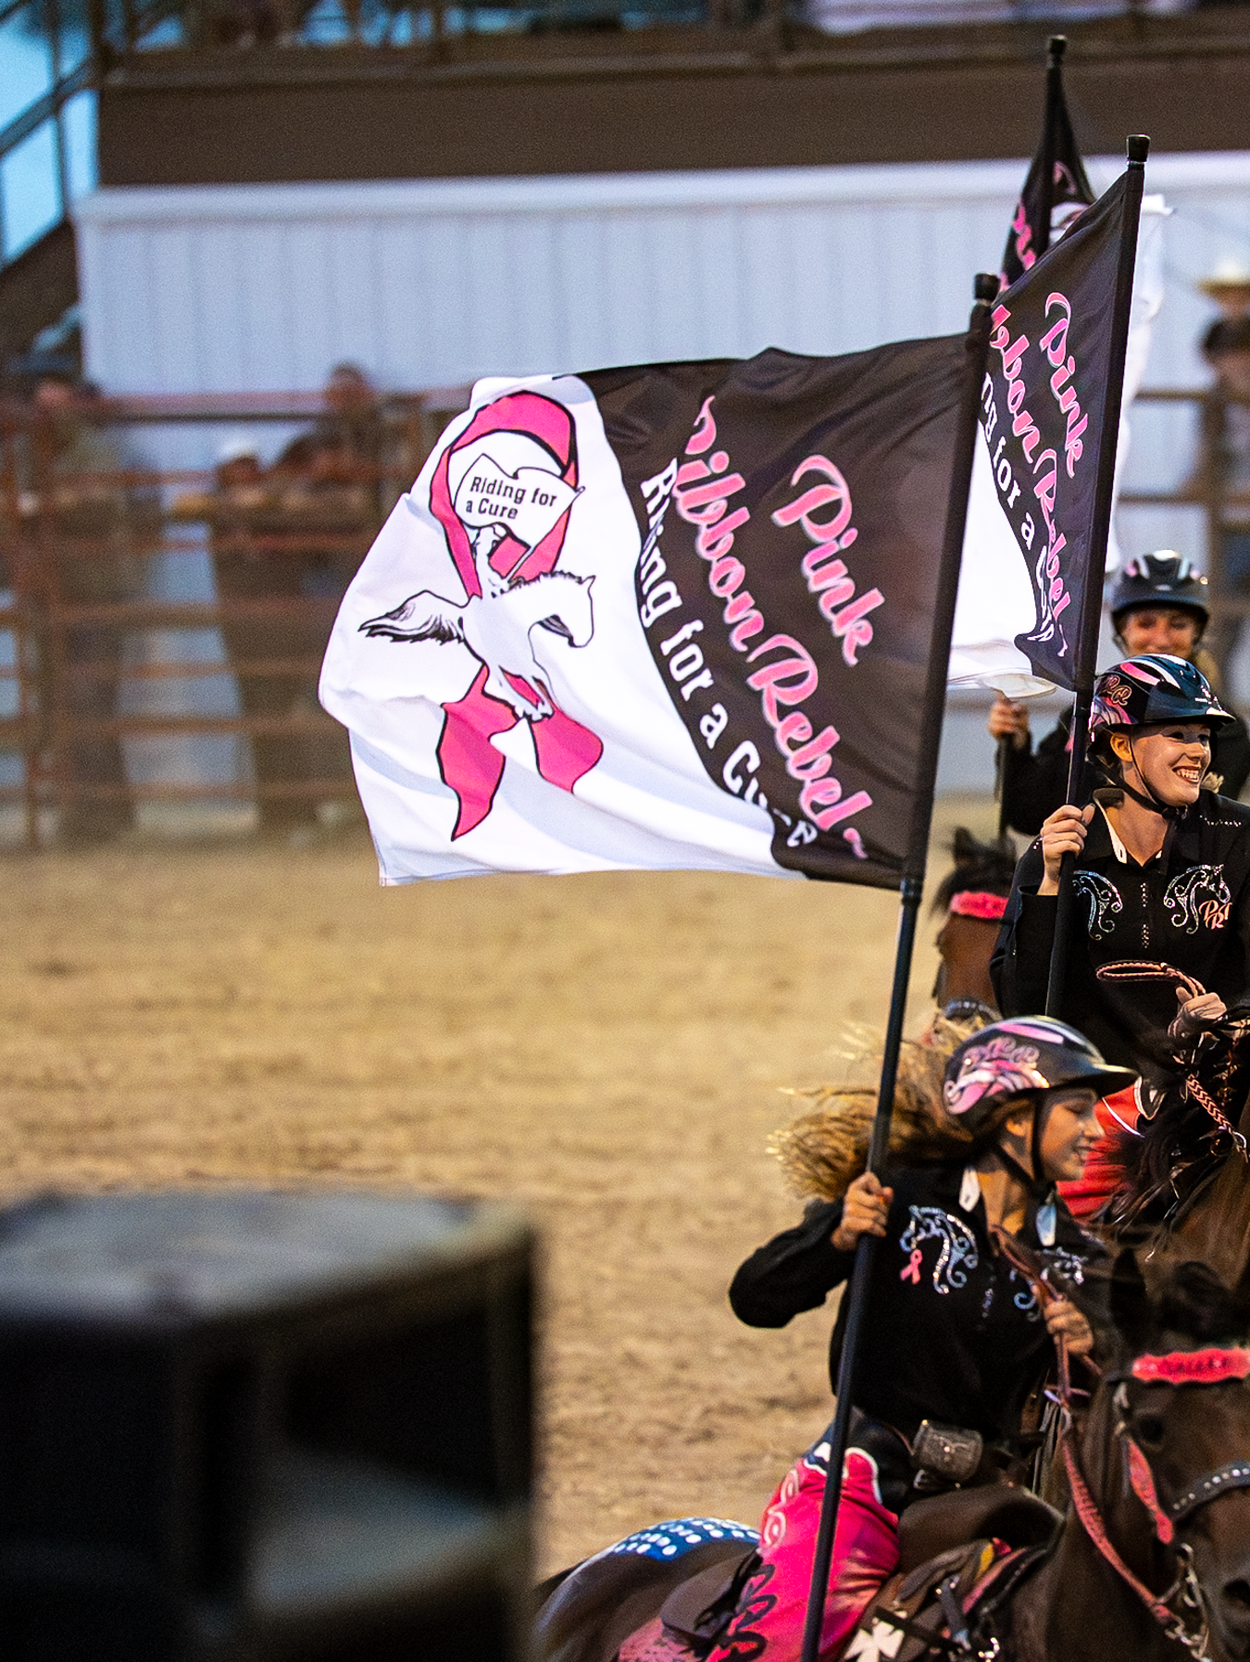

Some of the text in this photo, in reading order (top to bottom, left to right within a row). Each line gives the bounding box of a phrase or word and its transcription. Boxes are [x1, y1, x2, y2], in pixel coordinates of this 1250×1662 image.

[1039, 291, 1088, 479] Pink
[465, 498, 518, 519] a Cure
[470, 476, 557, 507] Riding for
[992, 436, 1022, 509] for
[1021, 511, 1035, 551] a
[640, 457, 683, 629] Riing
[771, 455, 885, 667] Pink
[660, 619, 714, 702] for
[700, 702, 729, 750] a
